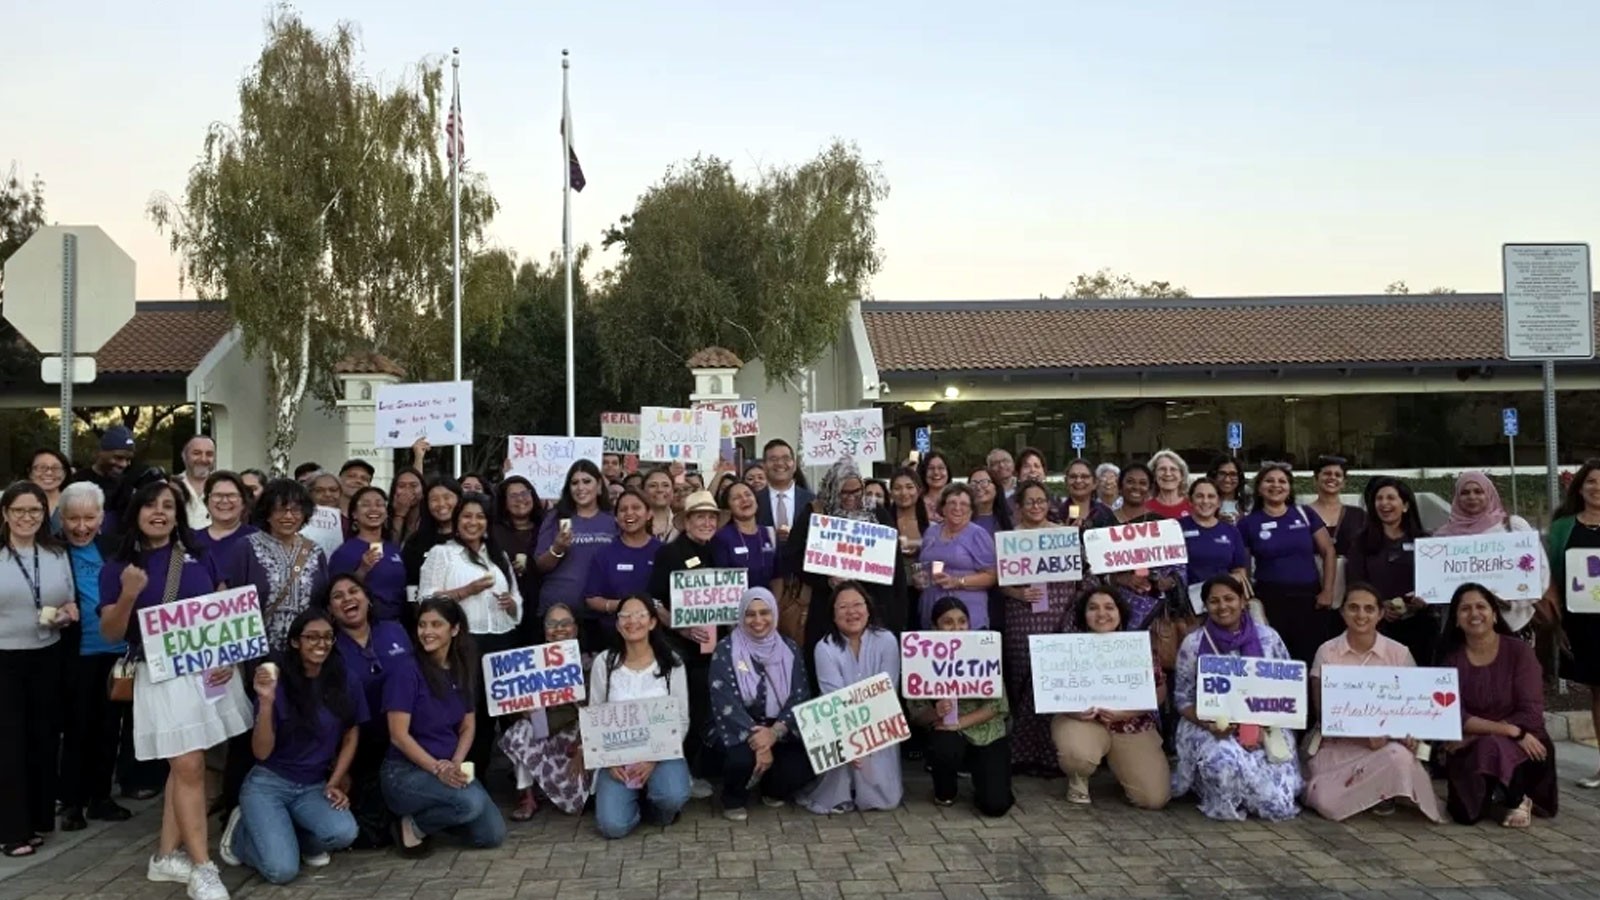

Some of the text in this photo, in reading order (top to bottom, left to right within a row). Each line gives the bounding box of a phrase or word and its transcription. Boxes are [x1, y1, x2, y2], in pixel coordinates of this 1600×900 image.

[656, 409, 703, 425] LOVE
[741, 402, 756, 418] UP
[655, 444, 705, 458] HURT
[852, 522, 896, 540] SHOULD
[1109, 521, 1161, 542] LOVE
[837, 542, 865, 556] NOT
[1003, 536, 1033, 555] NO
[1038, 532, 1080, 550] EXCUSE
[807, 550, 837, 569] TEAR
[841, 557, 862, 572] YOU
[999, 554, 1081, 578] FOR ABUSE
[144, 590, 260, 636] EMPOWER
[674, 606, 741, 625] BOUNDARIE
[162, 614, 262, 657] EDUCATE
[902, 633, 962, 661] STOP
[173, 648, 213, 677] END
[218, 636, 267, 667] ABUSE
[490, 645, 564, 678] HOPE IS
[932, 660, 1001, 678] VICTIM
[491, 664, 583, 701] STRONGER
[907, 673, 994, 697] BLAMING
[1203, 676, 1231, 694] END
[497, 687, 576, 713] THAN FEAR
[799, 678, 892, 731] STOP VIOLENCE
[831, 706, 872, 737] END
[602, 727, 650, 746] MATTERS
[810, 713, 911, 771] THE SILENCE
